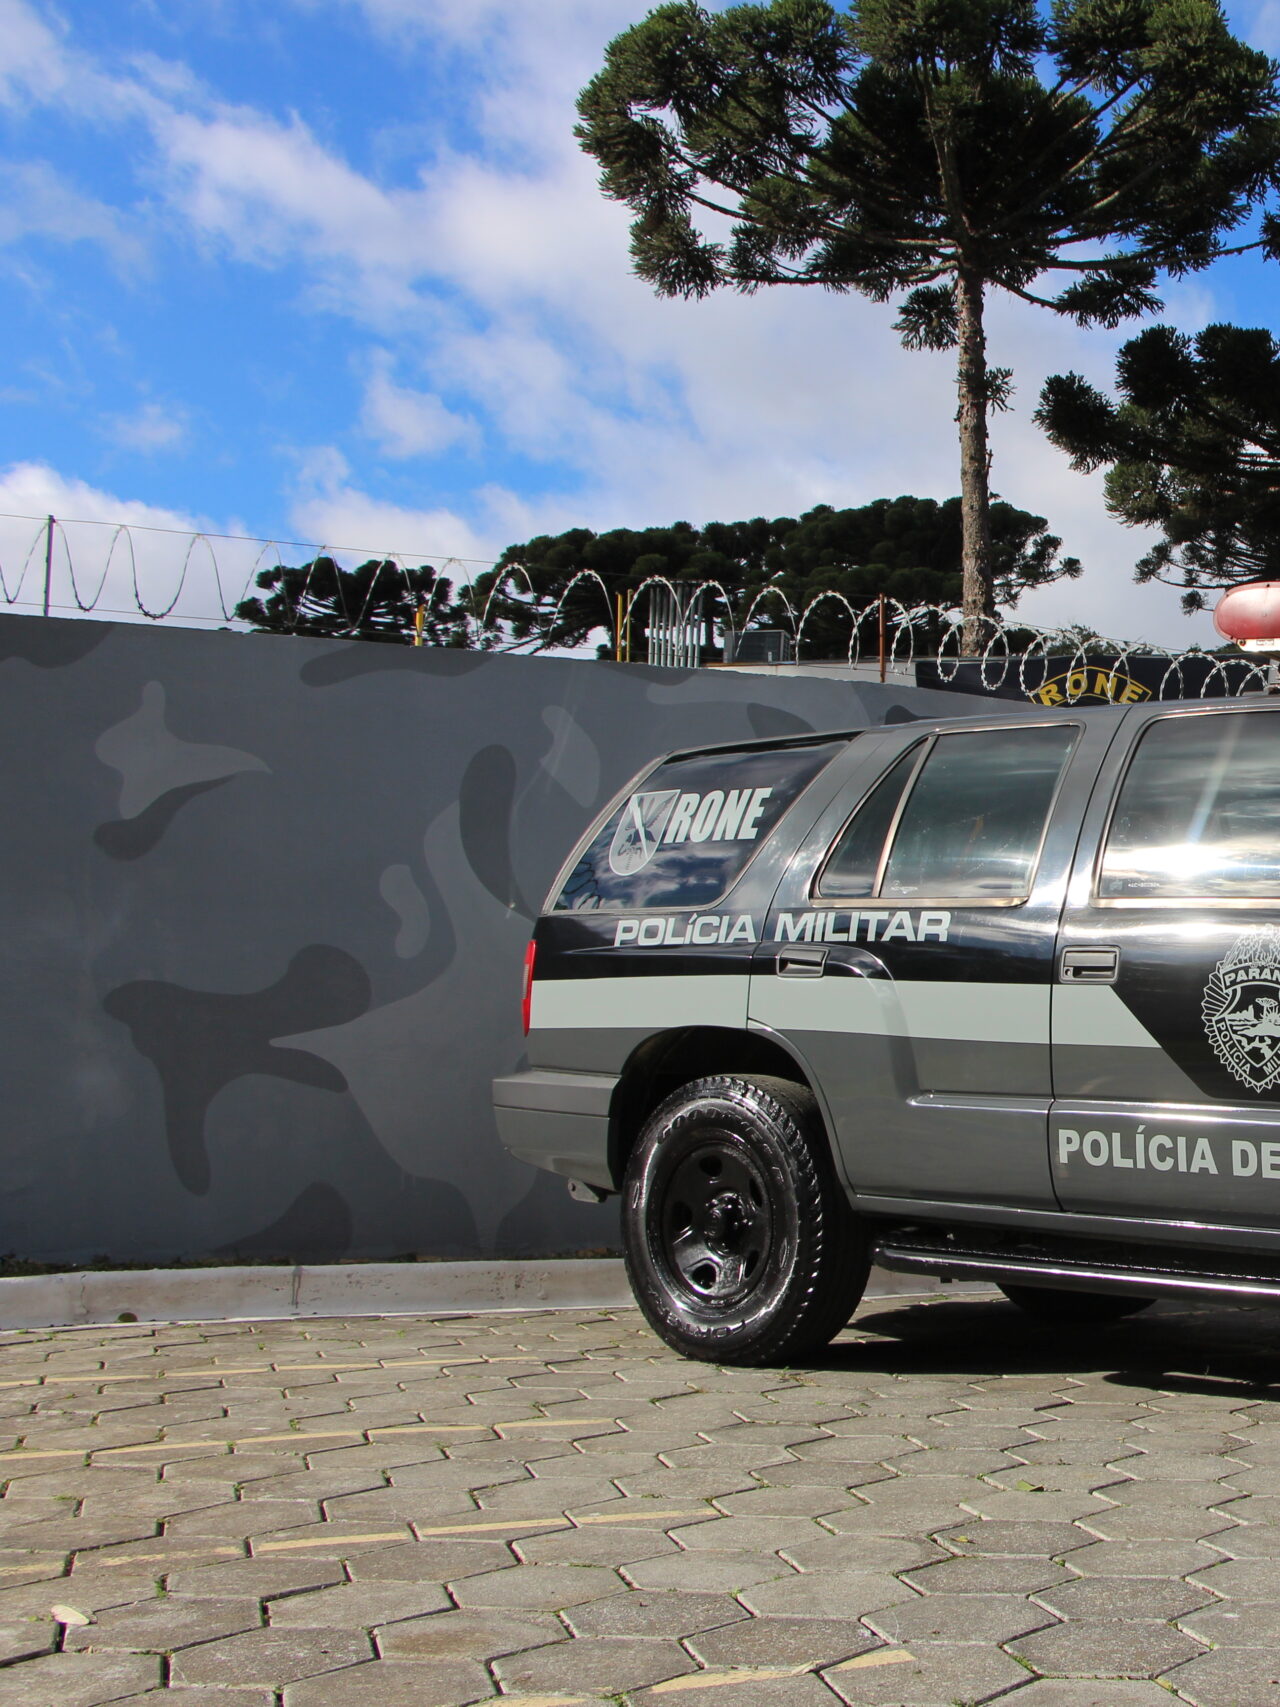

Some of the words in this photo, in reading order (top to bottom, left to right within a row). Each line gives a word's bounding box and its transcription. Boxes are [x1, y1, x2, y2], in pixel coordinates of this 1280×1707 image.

[1039, 673, 1143, 706] RONE
[663, 787, 773, 844] RONE
[614, 911, 756, 946] POLÍCIA
[773, 911, 951, 942] MILITAR
[1058, 1124, 1219, 1175] POLÍCIA
